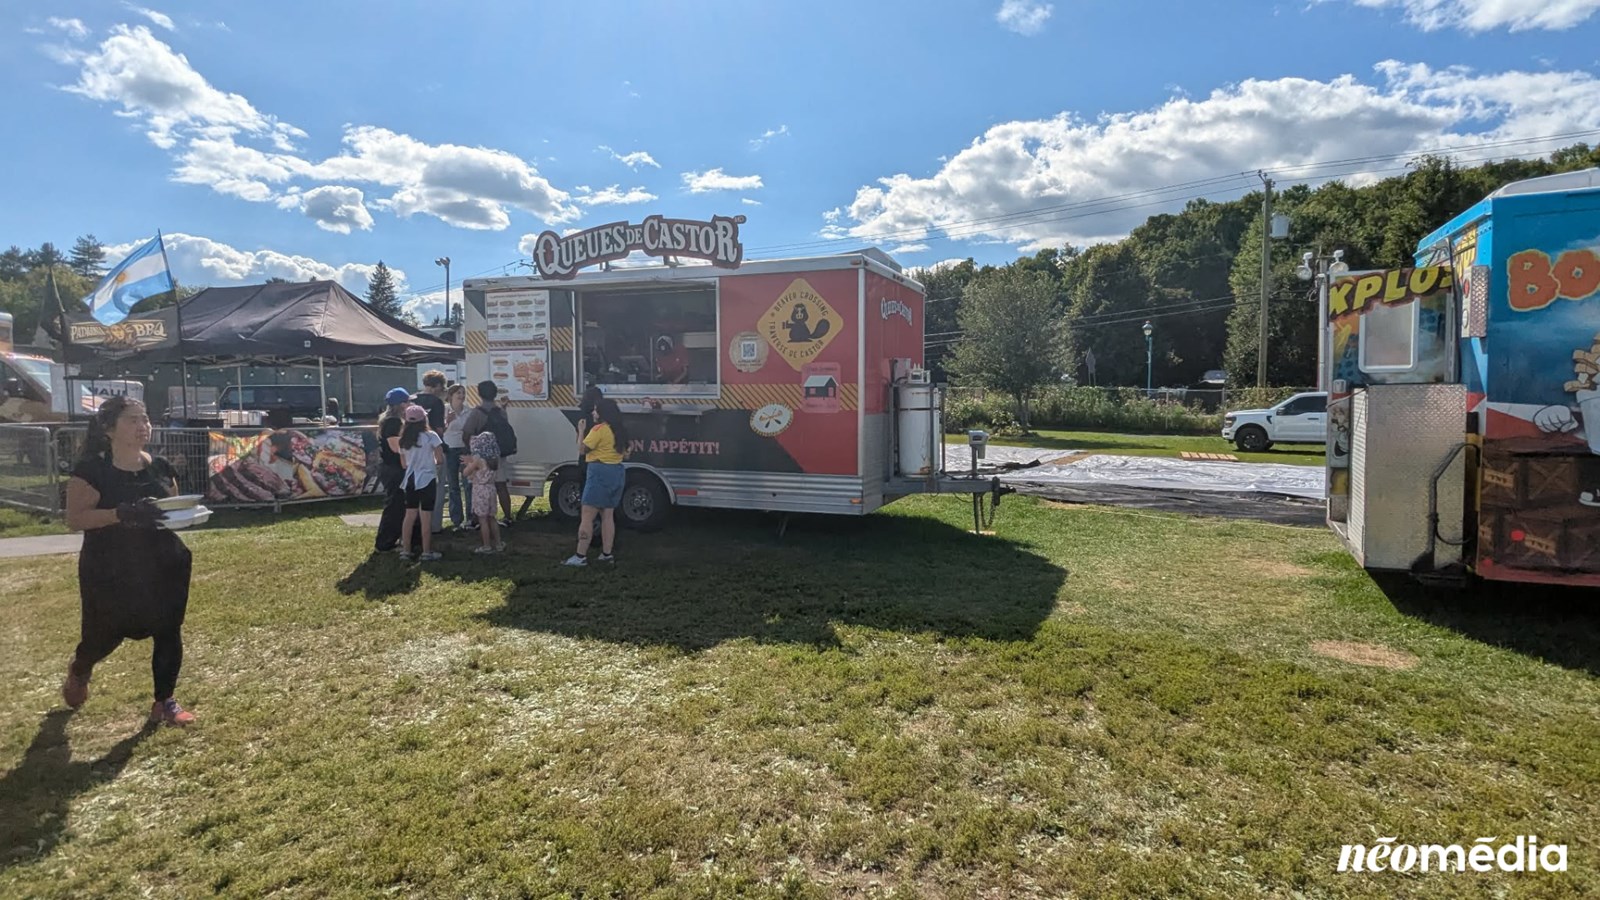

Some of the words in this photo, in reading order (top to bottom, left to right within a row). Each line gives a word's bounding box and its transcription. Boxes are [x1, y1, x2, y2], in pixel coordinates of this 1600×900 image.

[537, 224, 627, 275] QUEUES
[626, 227, 644, 245] DE
[643, 218, 738, 263] CASTOR
[774, 292, 797, 312] BEAVER
[800, 291, 829, 316] CROSSING
[135, 322, 167, 337] BBQ
[768, 321, 788, 354] TRAVERSE
[789, 350, 797, 358] DE
[800, 339, 825, 357] CASTOR
[648, 438, 720, 455] APPÉTIT!
